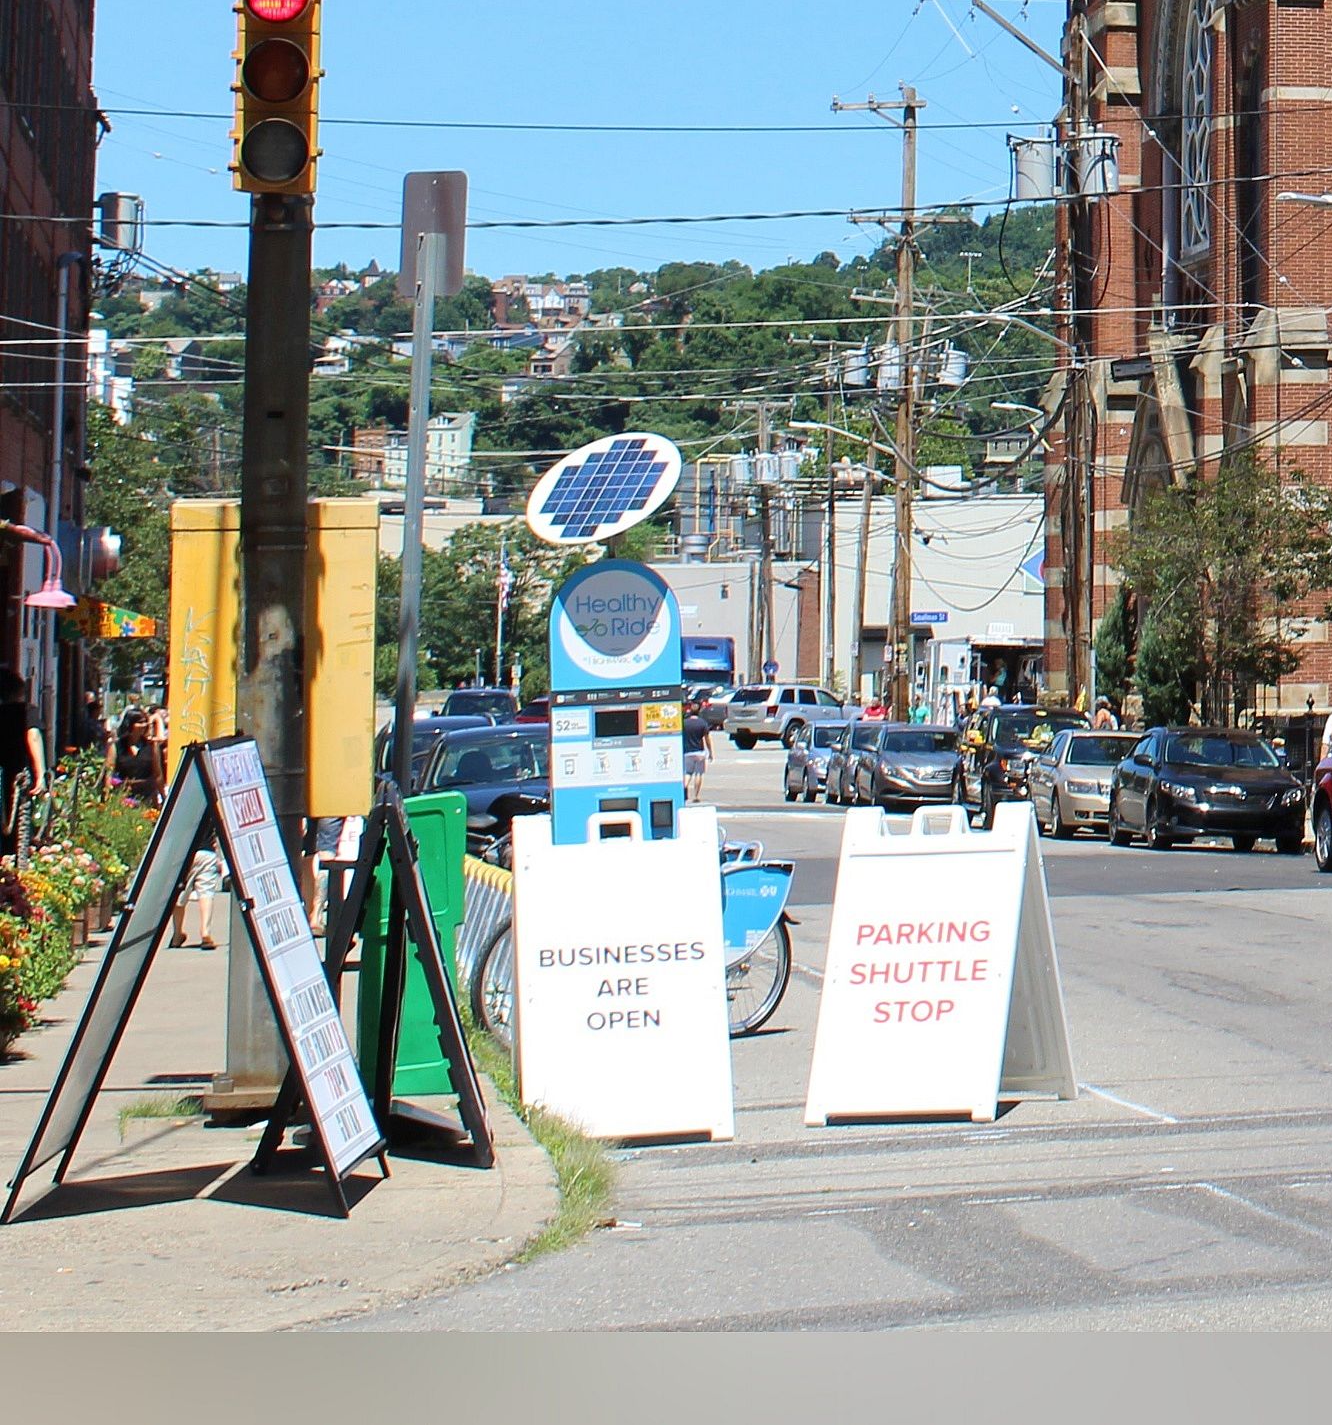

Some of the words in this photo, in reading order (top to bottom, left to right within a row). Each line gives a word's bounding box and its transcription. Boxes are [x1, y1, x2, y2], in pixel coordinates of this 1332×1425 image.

[575, 593, 660, 615] Healthy
[611, 617, 661, 637] Ride
[855, 920, 991, 946] PARKING
[538, 941, 706, 968] BUSINESSES
[849, 959, 988, 985] SHUTTLE
[596, 977, 650, 999] ARE
[586, 1009, 661, 1031] OPEN
[873, 999, 955, 1024] STOP
